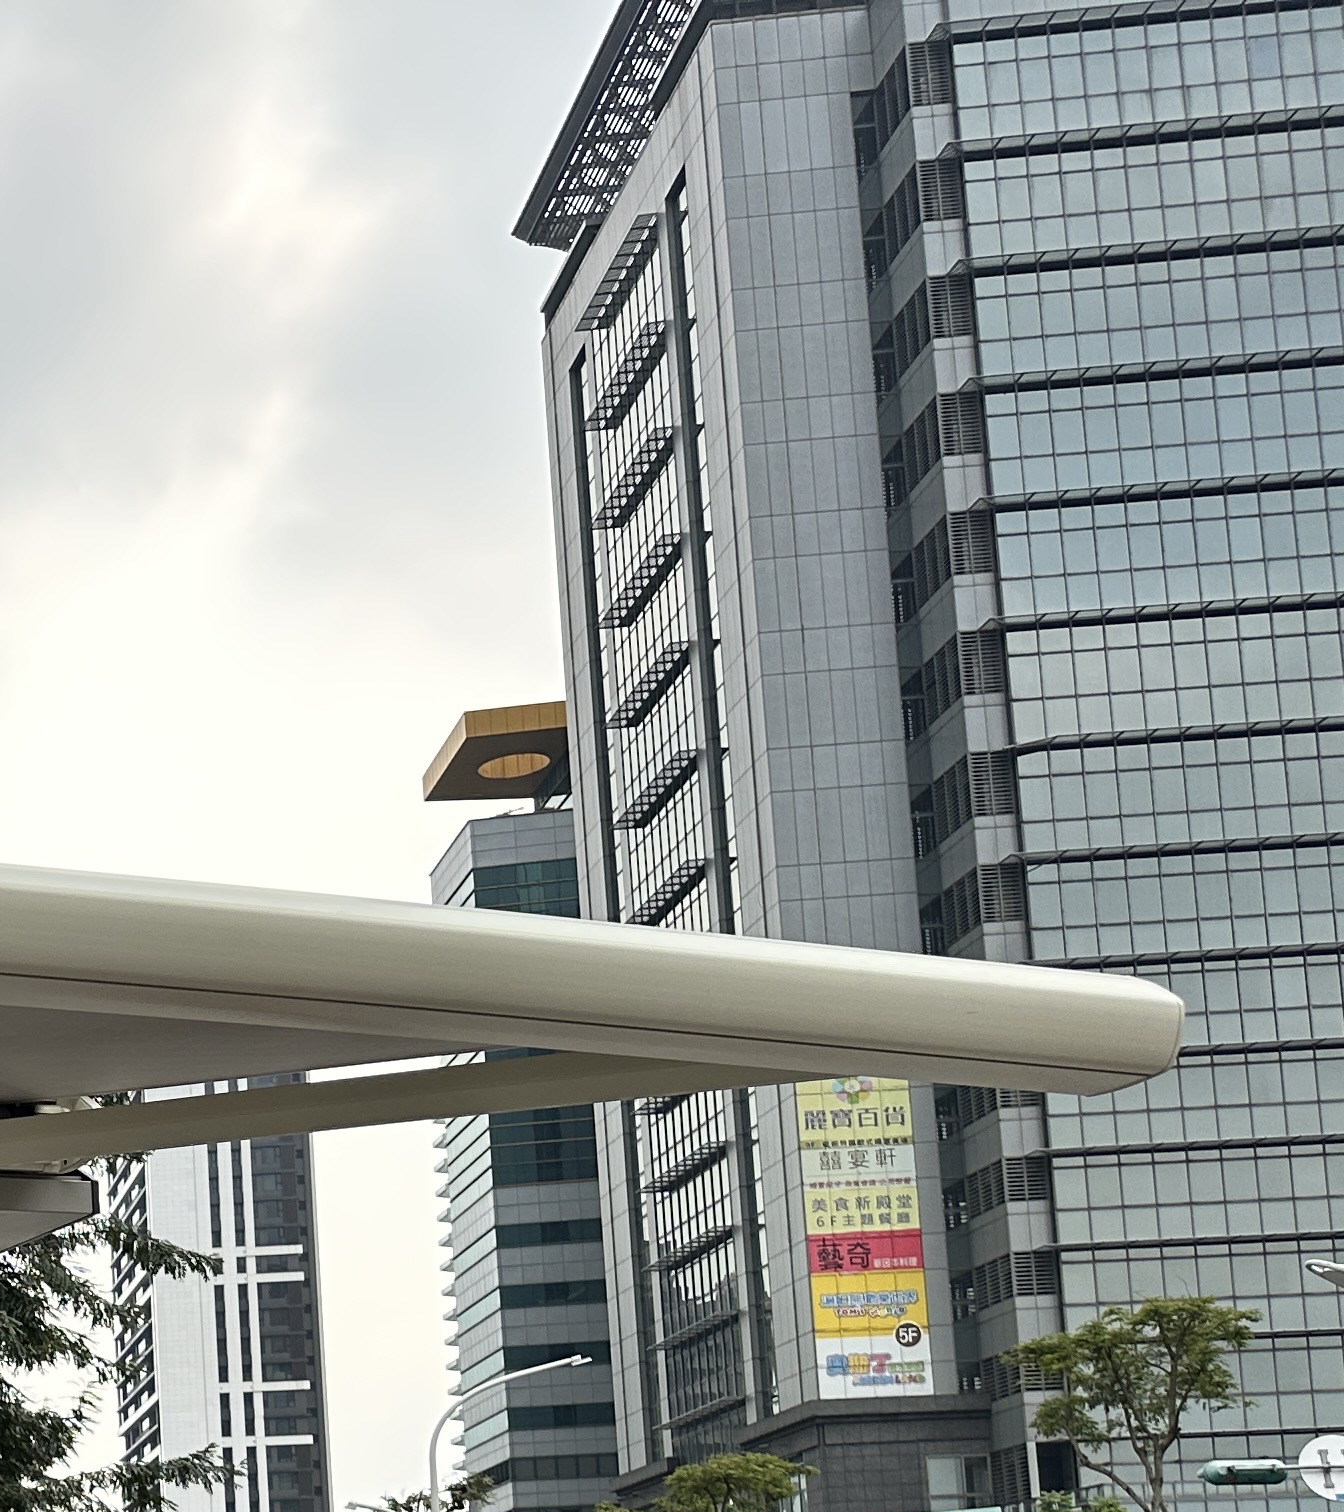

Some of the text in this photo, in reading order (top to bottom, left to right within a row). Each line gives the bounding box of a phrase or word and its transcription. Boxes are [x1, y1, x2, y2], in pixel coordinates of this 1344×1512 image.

[812, 1194, 912, 1213] 美食新殿堂
[817, 1237, 872, 1271] 藝奇
[899, 1326, 918, 1343] 5F
